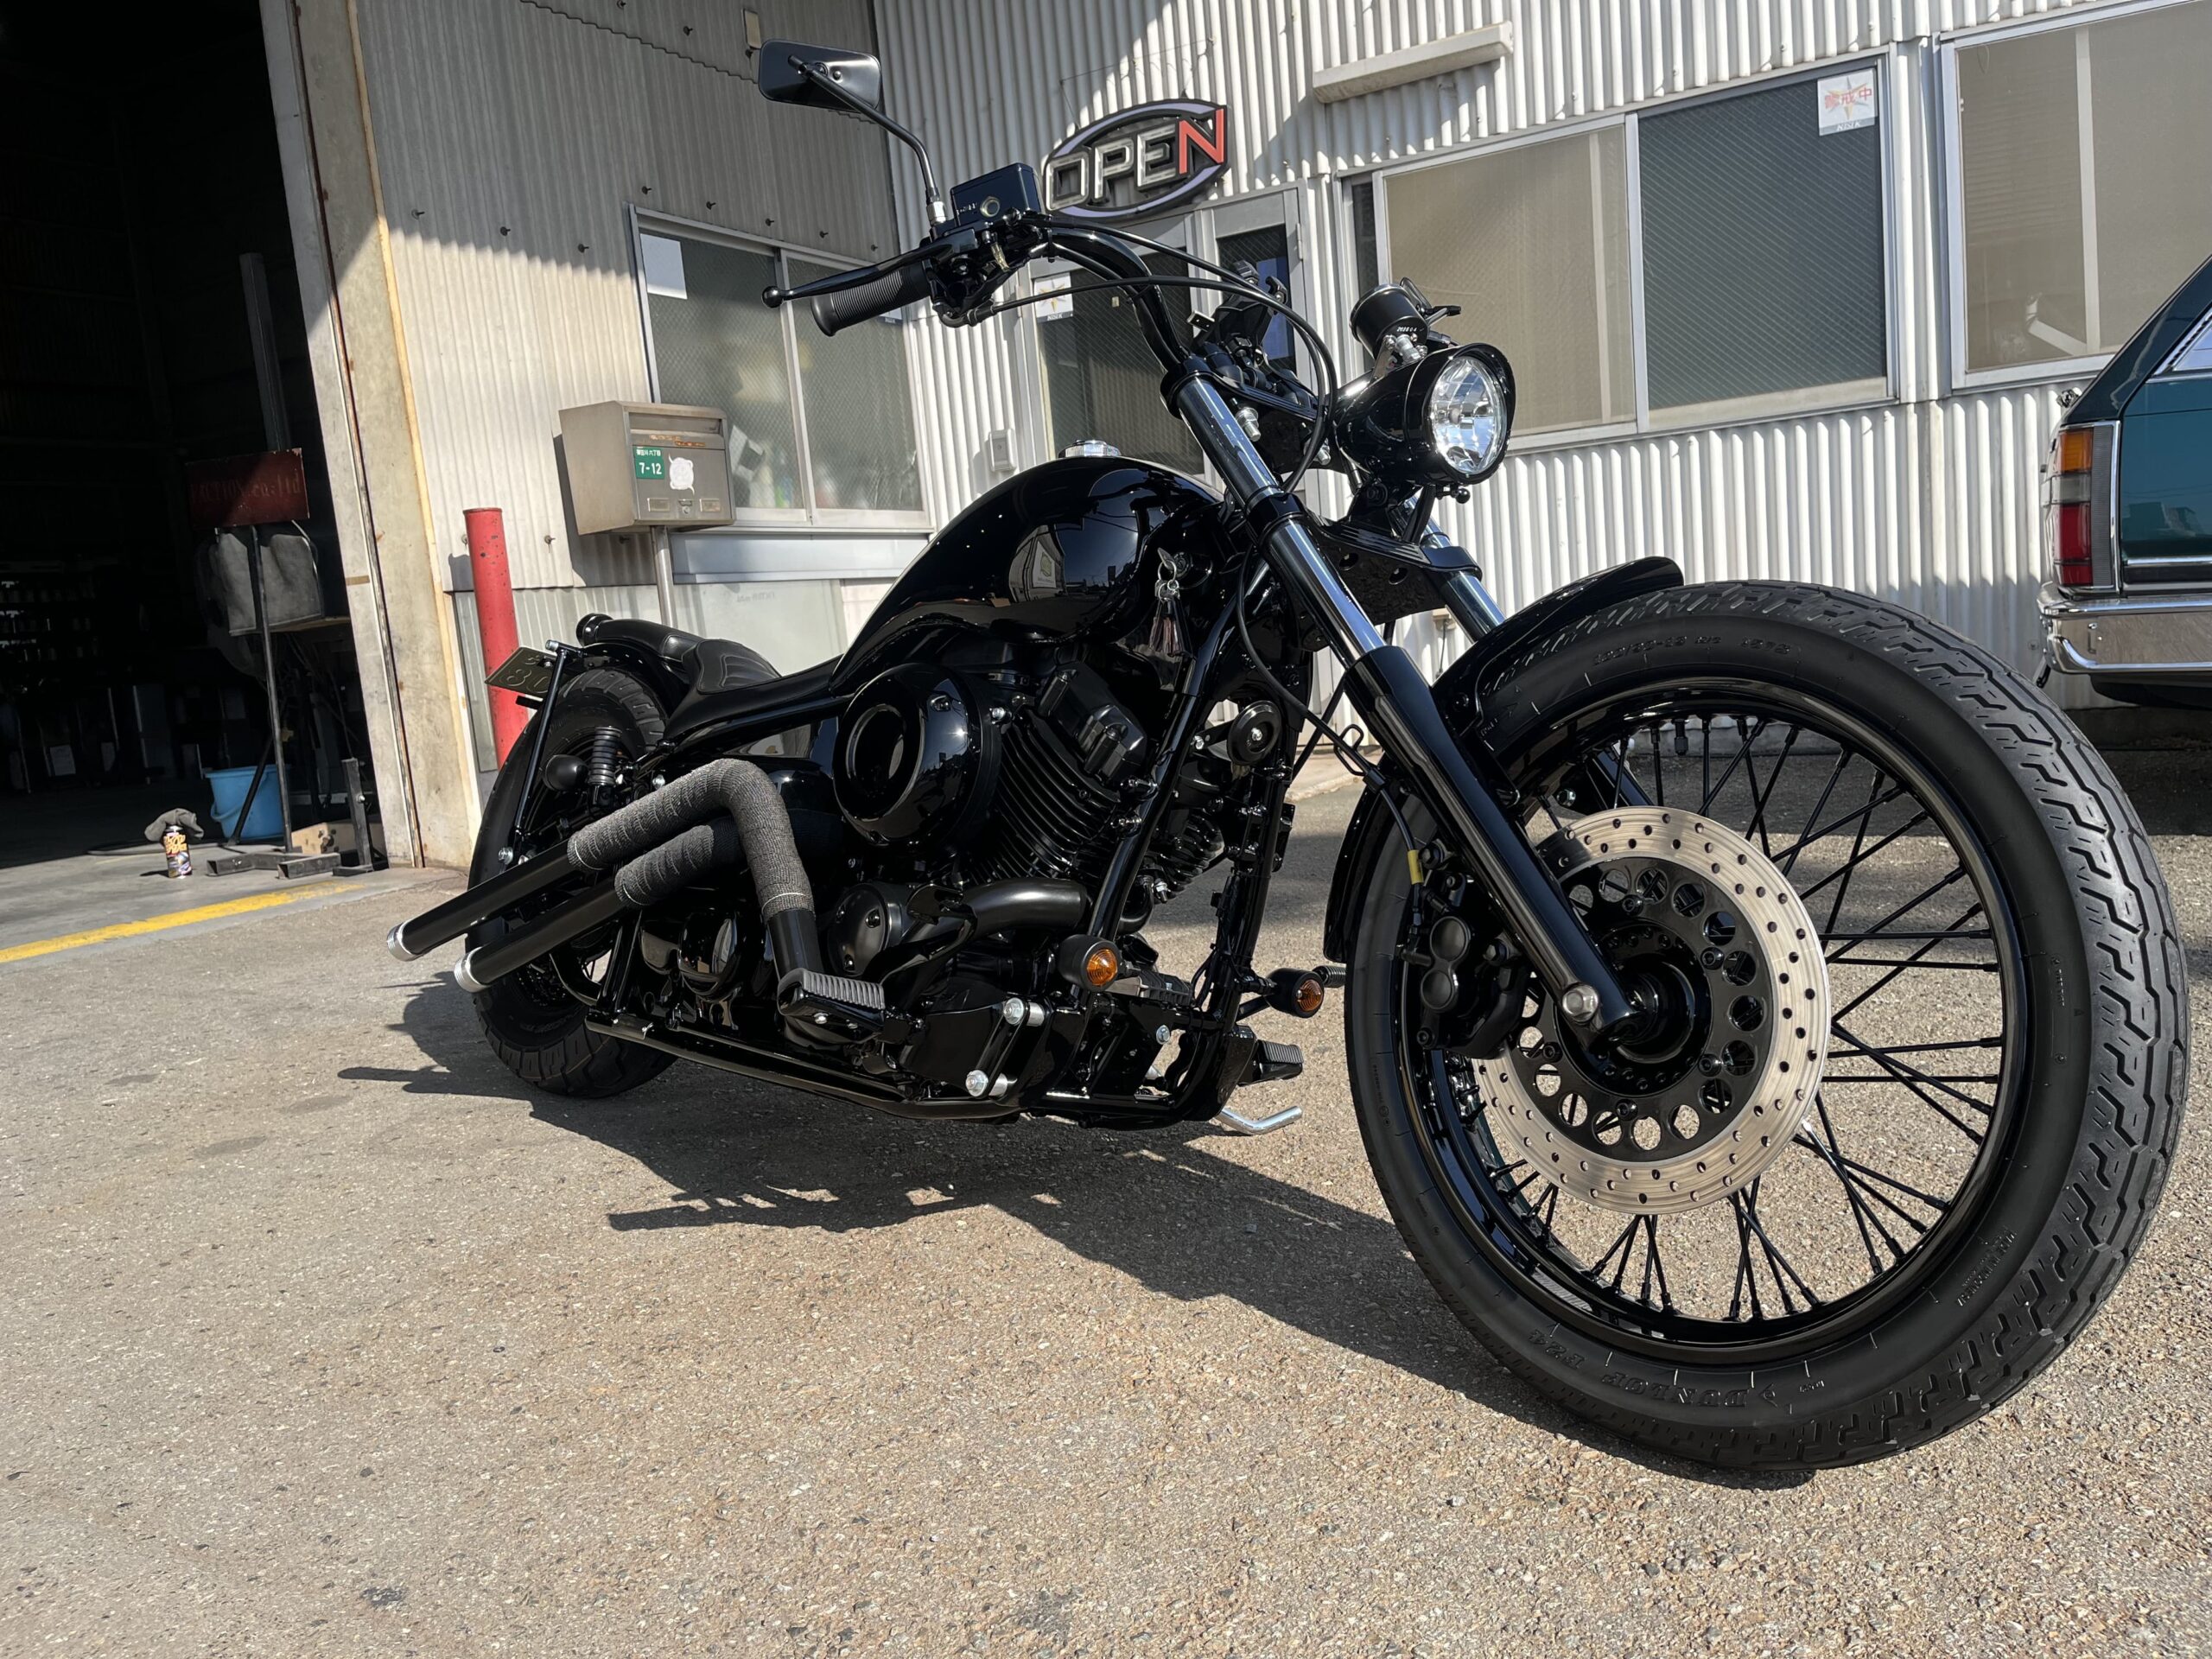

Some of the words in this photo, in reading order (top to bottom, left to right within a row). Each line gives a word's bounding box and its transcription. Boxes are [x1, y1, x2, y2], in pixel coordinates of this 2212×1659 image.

[1045, 107, 1225, 212] OPEN
[639, 461, 663, 475] 7-12
[1527, 1328, 1586, 1371] F24
[1600, 1371, 1751, 1409] DUNLOP
